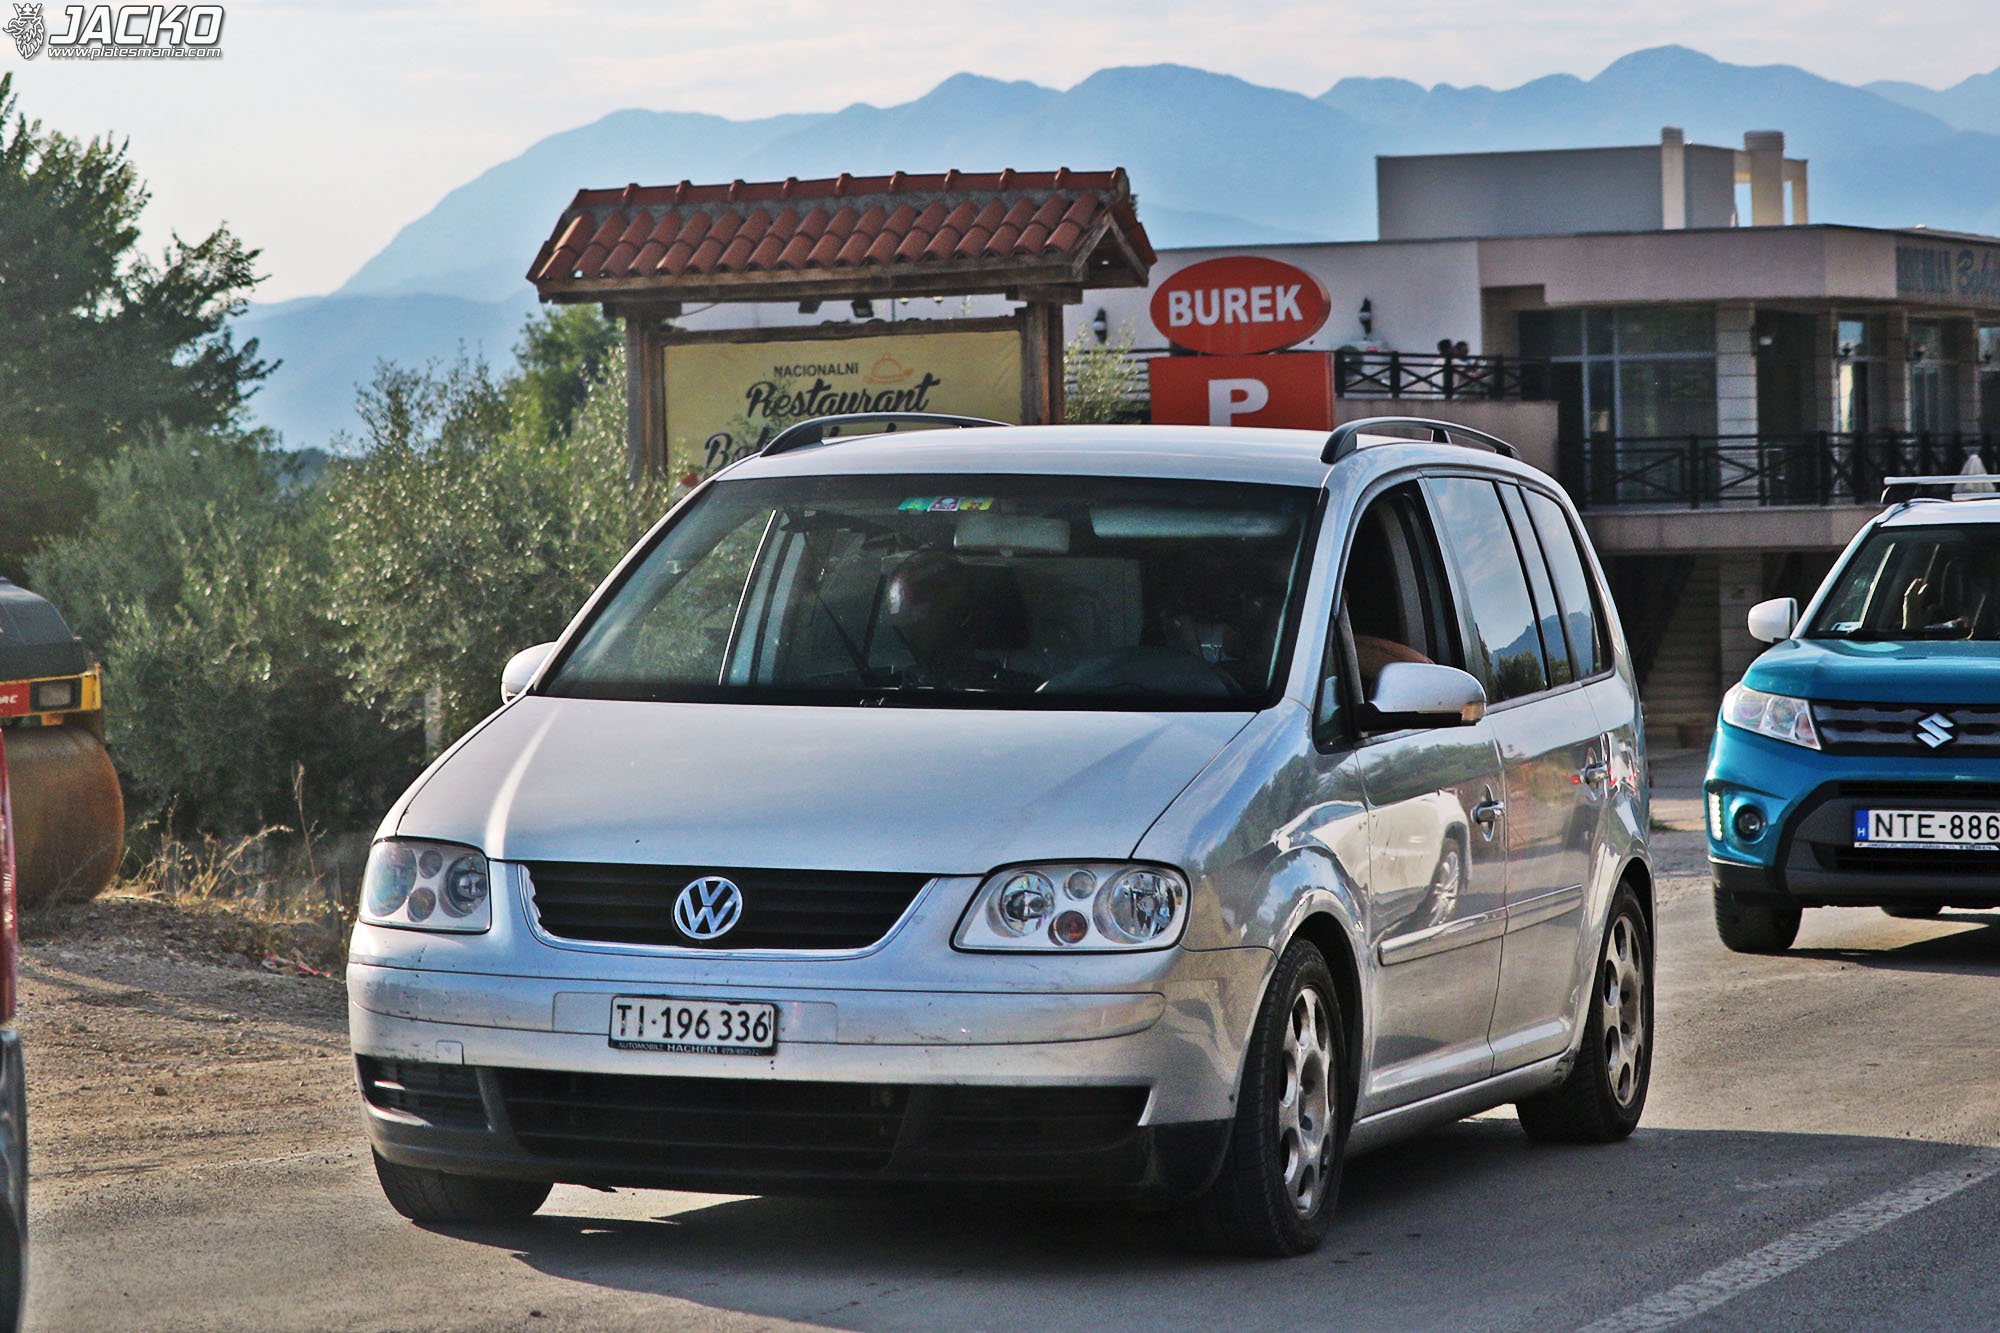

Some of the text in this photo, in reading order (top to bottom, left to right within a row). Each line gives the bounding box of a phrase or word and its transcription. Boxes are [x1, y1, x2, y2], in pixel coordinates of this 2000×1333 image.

[1168, 275, 1303, 327] BUREK
[773, 362, 859, 378] NACIONALNI
[746, 372, 941, 418] Restaurant
[1208, 378, 1269, 426] P
[1857, 828, 1866, 837] H
[1875, 813, 2000, 840] NTE-886
